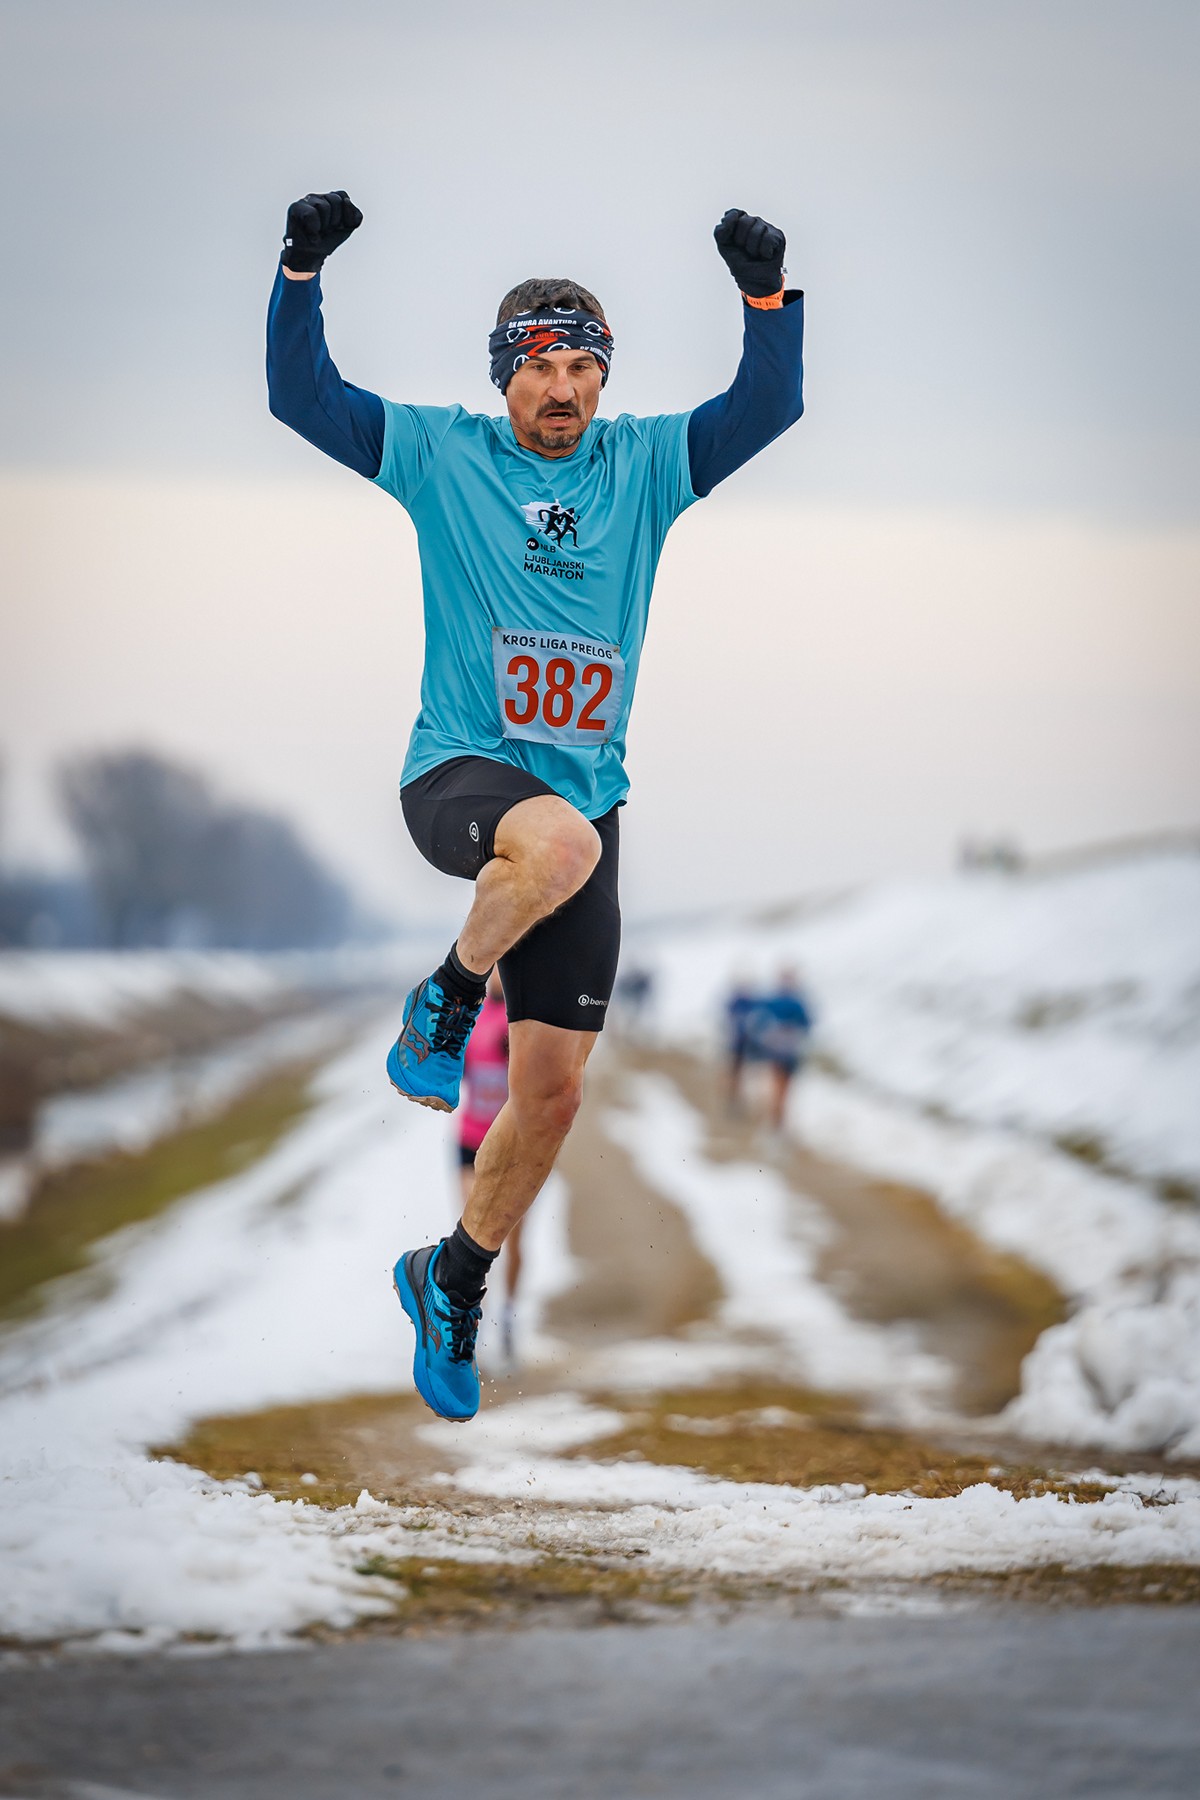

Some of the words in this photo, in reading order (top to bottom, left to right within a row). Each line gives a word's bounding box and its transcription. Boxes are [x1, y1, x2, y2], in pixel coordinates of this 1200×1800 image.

[517, 319, 537, 327] MURA
[537, 318, 577, 326] AVANTURA
[540, 543, 556, 553] NLB
[523, 561, 585, 580] MARATON
[524, 553, 585, 570] LJUBLJANSKI
[502, 633, 537, 648] KROS
[540, 637, 568, 651] LIGA
[571, 641, 613, 660] PRELOG
[504, 655, 613, 731] 382
